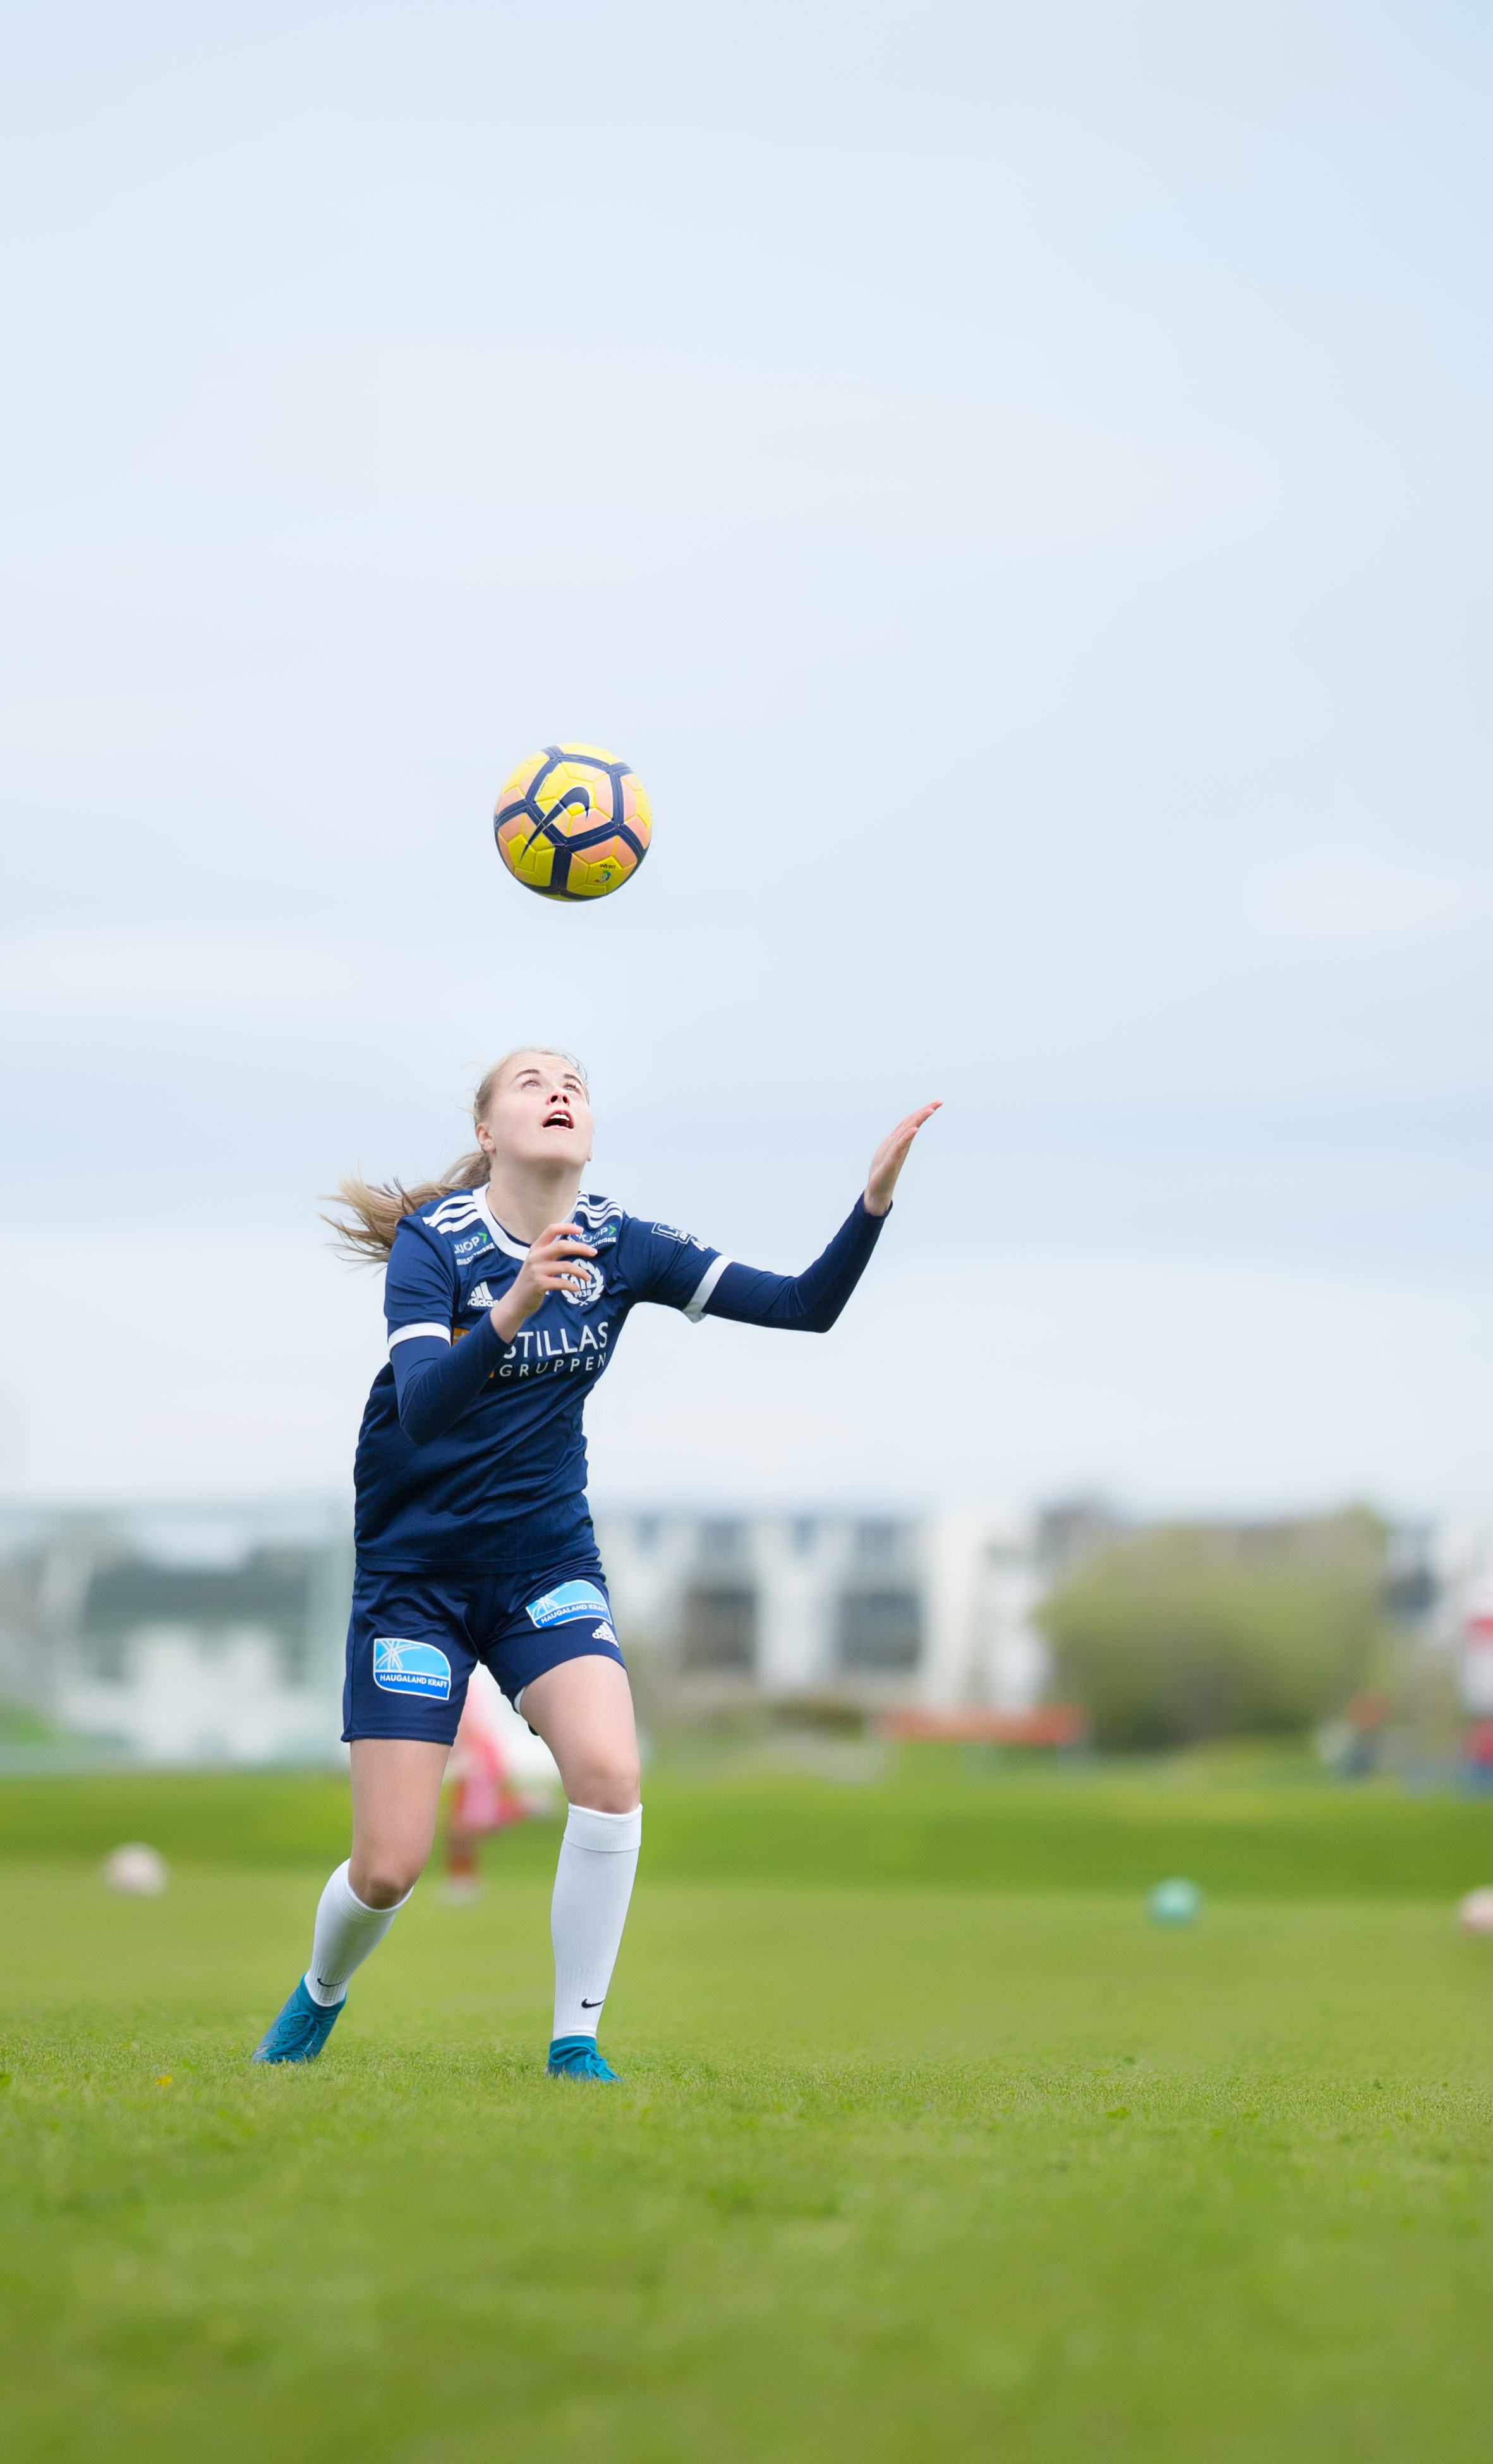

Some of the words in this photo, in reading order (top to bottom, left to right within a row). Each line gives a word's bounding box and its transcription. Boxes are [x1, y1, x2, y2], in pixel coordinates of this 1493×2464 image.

[499, 1352, 607, 1377] GRUPPEN
[540, 1604, 588, 1624] HAUGALAND
[588, 1603, 608, 1614] KRAFT
[380, 1674, 426, 1685] HAUGALAND
[427, 1678, 448, 1688] KRAFT
